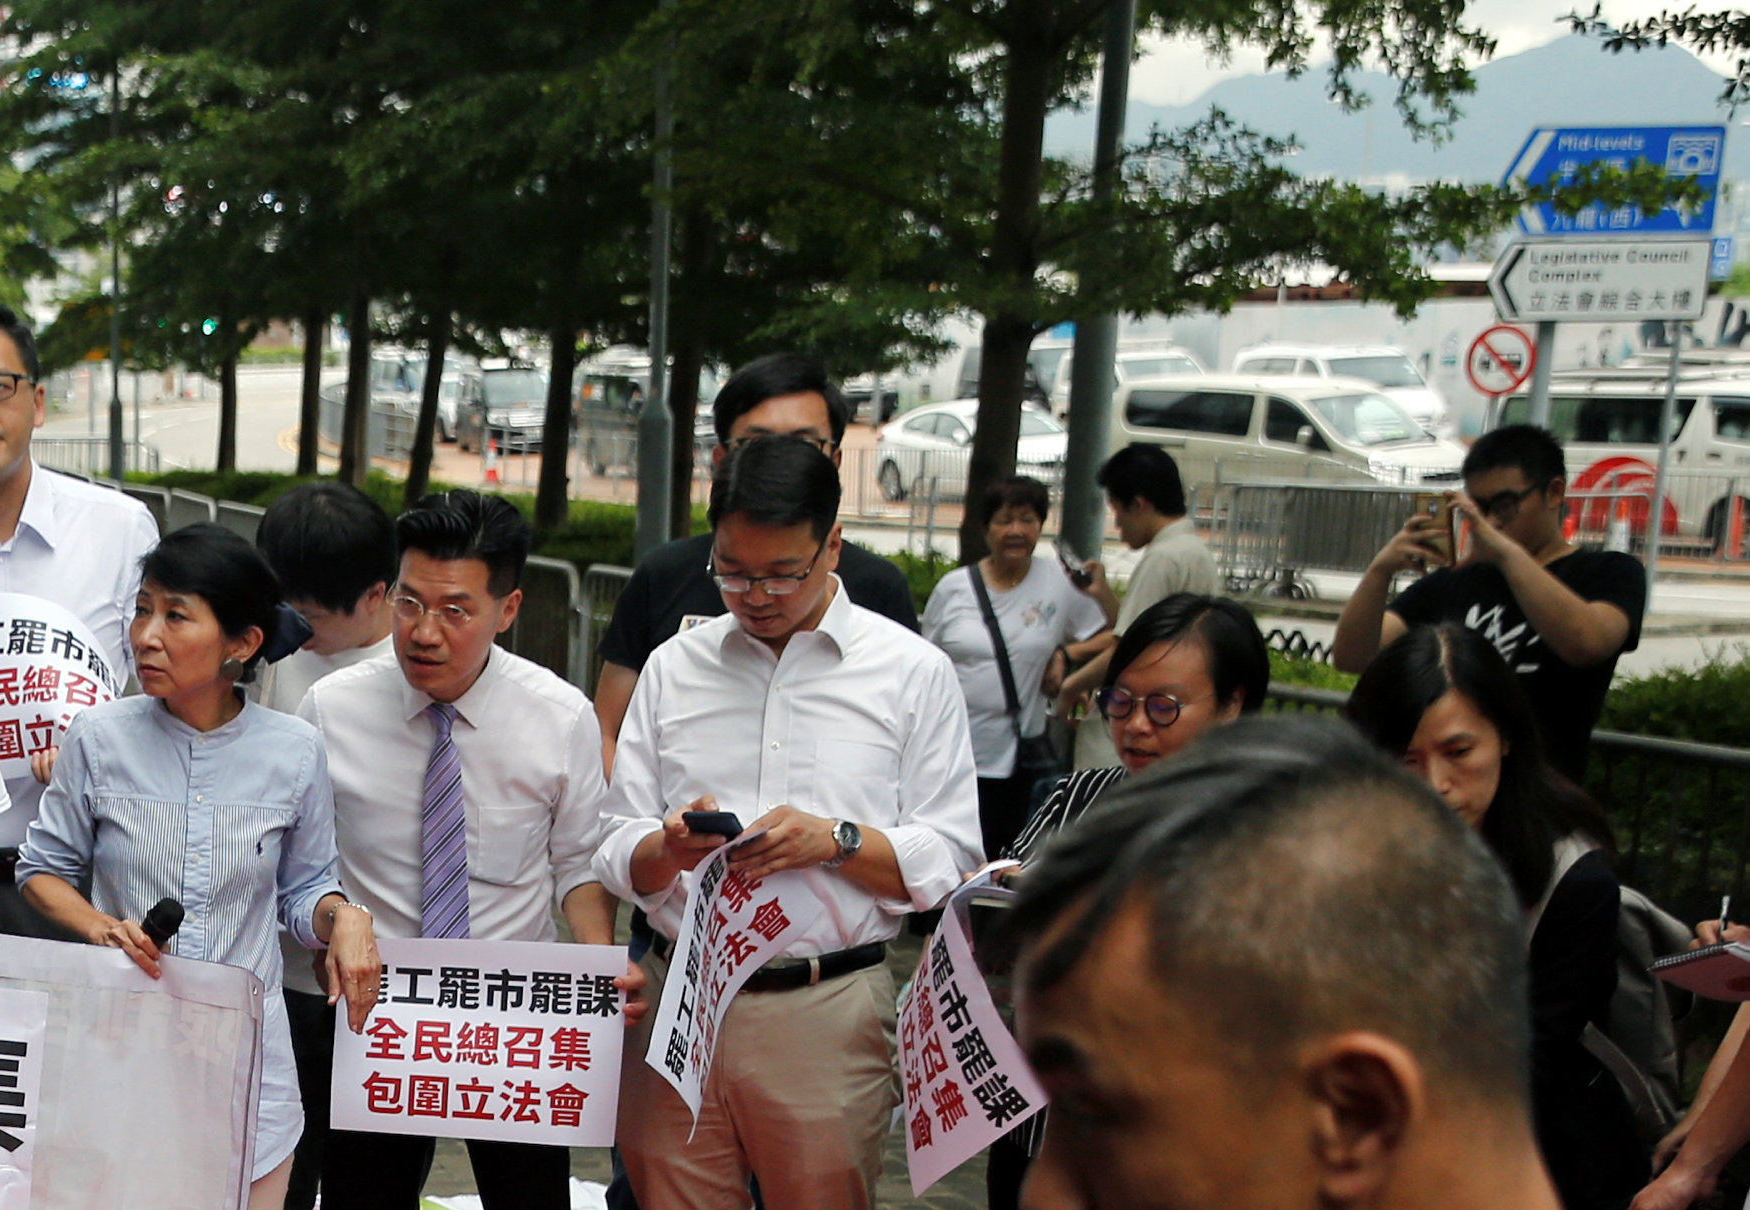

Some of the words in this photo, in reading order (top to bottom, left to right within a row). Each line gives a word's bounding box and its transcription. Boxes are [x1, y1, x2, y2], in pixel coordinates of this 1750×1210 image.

[1557, 134, 1646, 151] Mid-levels
[1530, 250, 1620, 266] Legislative
[1626, 250, 1689, 265] Council
[1528, 270, 1601, 284] Complex
[1529, 289, 1691, 313] 立法會綜合大樓
[365, 1016, 592, 1072] 全民總召集
[361, 1071, 589, 1128] 包圍立法會
